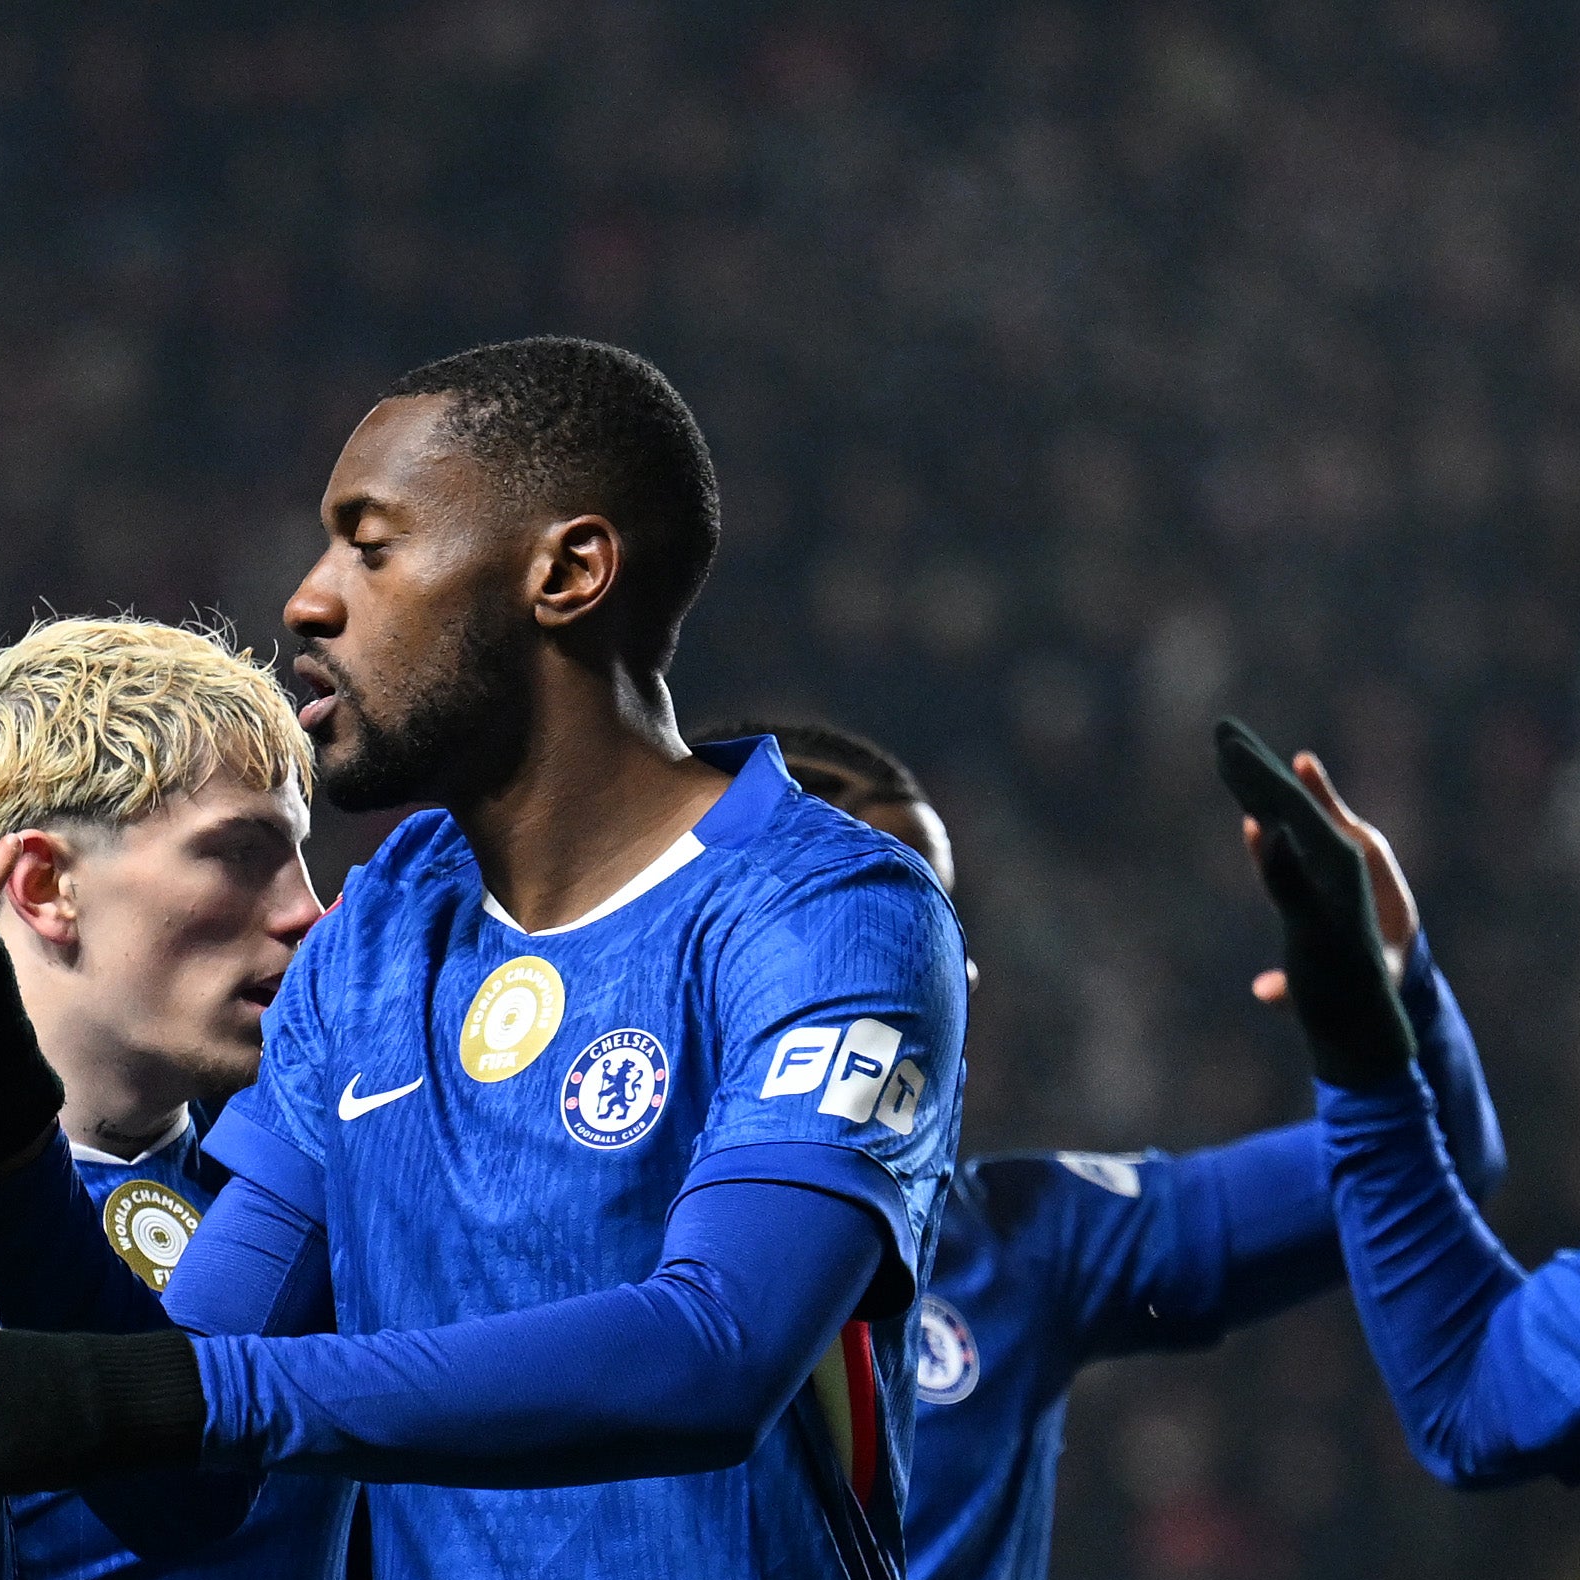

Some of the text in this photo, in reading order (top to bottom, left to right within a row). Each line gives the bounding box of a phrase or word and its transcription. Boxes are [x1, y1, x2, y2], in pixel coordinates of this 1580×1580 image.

[589, 1033, 657, 1059] CHELSEA
[573, 1121, 646, 1143] FOOTBALL CLUB
[115, 1189, 199, 1251] WORLD CHAMPIO
